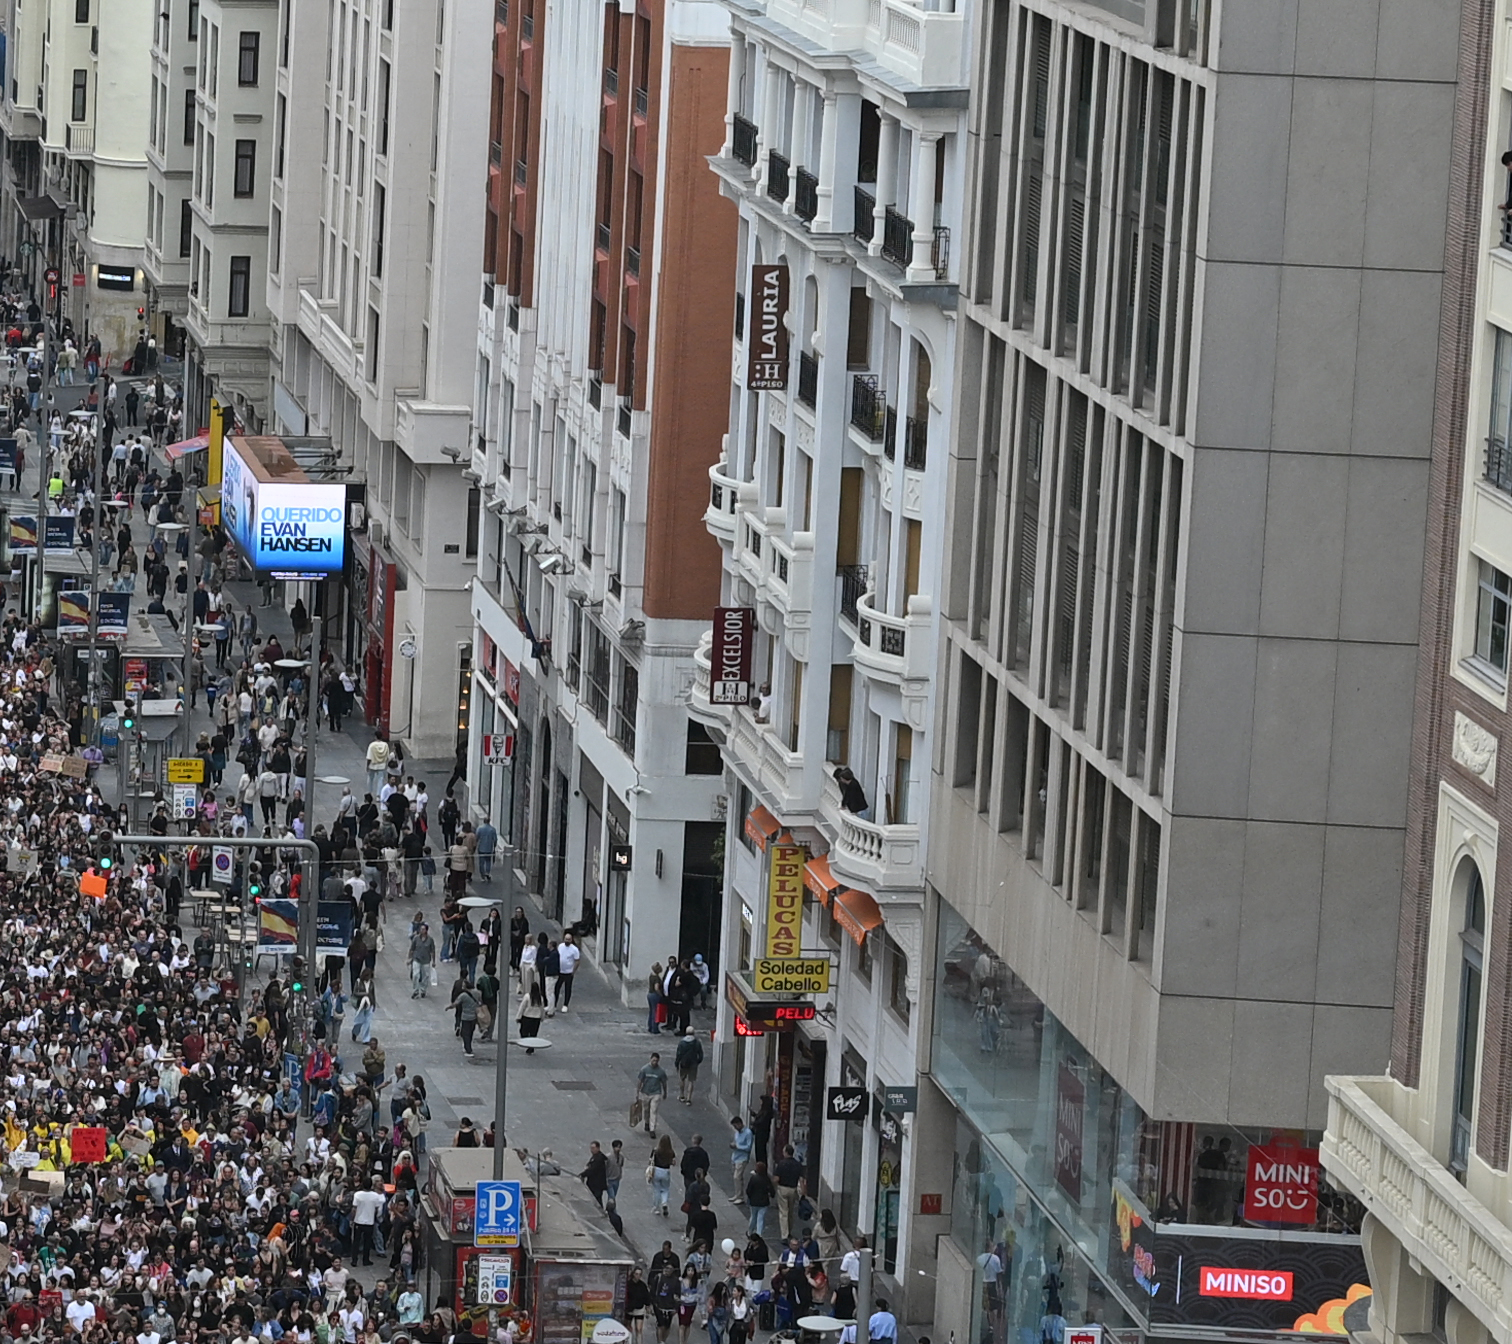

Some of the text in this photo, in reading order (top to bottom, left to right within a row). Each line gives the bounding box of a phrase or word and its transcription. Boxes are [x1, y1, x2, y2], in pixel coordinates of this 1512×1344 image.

[761, 269, 779, 359] LAURIA
[261, 507, 342, 523] QUERIDO
[261, 522, 306, 536] EVAN
[261, 538, 331, 552] HANSEN
[722, 611, 743, 681] EXCELSIOR
[488, 757, 507, 765] KFC
[771, 848, 800, 956] PELUCAS
[759, 961, 824, 975] Soledad
[761, 977, 822, 991] Cabello
[1254, 1162, 1310, 1184] MINI
[484, 1189, 512, 1226] P
[1206, 1272, 1286, 1295] MINISO
